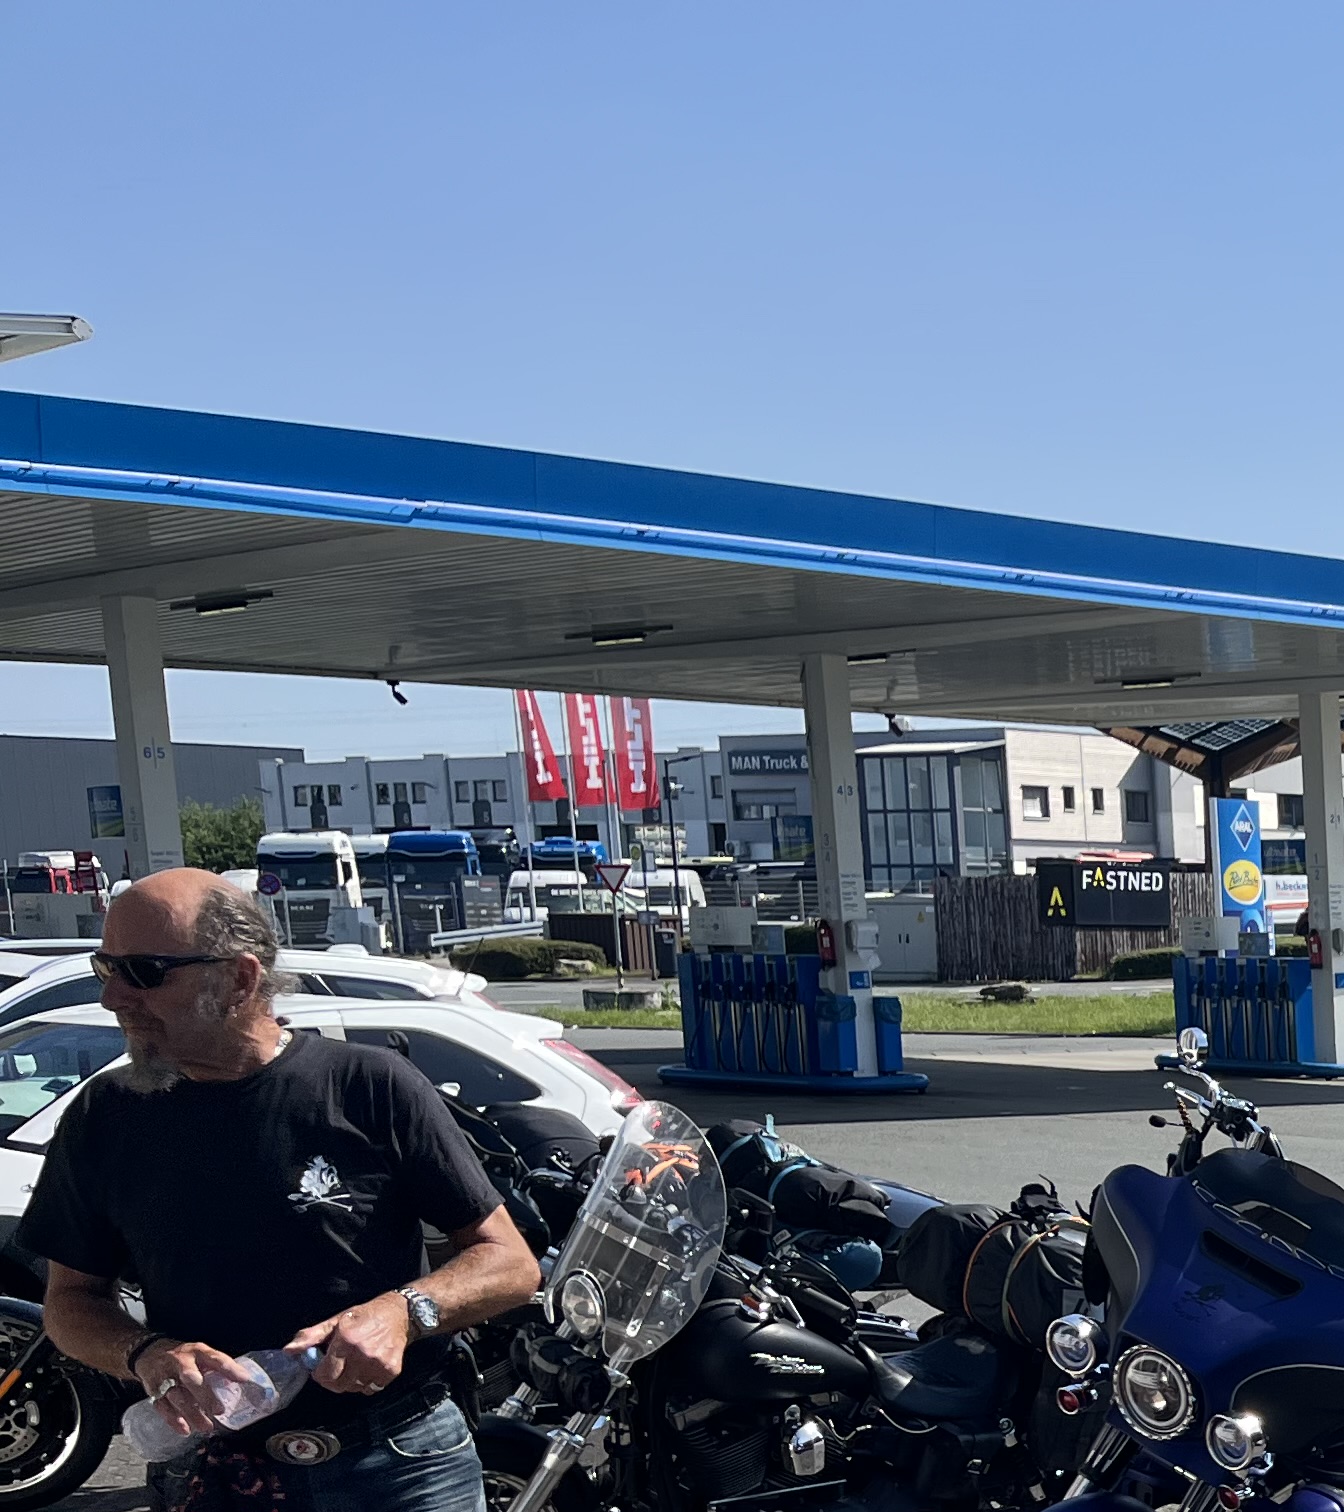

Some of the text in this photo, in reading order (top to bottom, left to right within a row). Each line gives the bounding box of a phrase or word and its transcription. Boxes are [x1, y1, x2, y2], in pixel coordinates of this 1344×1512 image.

[575, 693, 603, 789] HILT
[623, 697, 647, 793] HILT
[731, 755, 809, 770] MAN Truck &
[1234, 820, 1253, 833] ARAL
[1082, 866, 1163, 892] FASTNED
